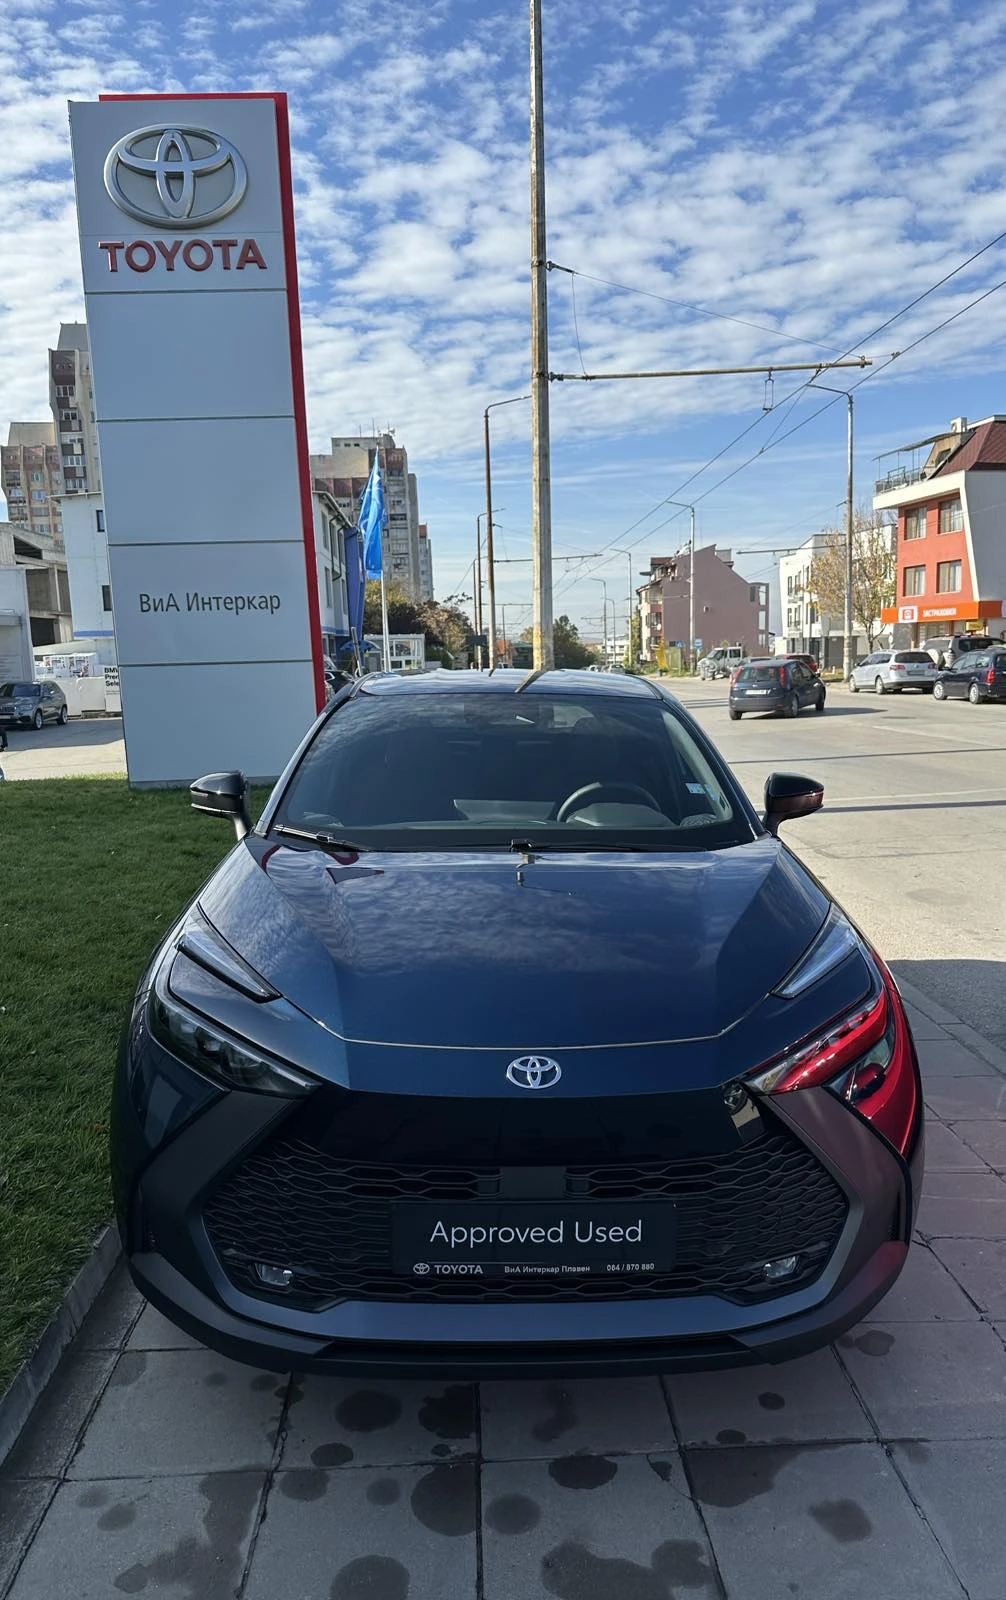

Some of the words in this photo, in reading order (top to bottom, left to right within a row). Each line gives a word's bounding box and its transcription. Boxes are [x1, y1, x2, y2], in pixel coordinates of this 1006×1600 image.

[98, 238, 268, 273] TOYOTA
[139, 593, 181, 613] ВиА
[186, 592, 281, 615] Интеркар
[430, 1220, 564, 1248] Approved
[575, 1219, 642, 1243] Used
[434, 1264, 484, 1274] TOYOTA
[504, 1265, 521, 1273] ВиА
[522, 1265, 560, 1275] Интеркар
